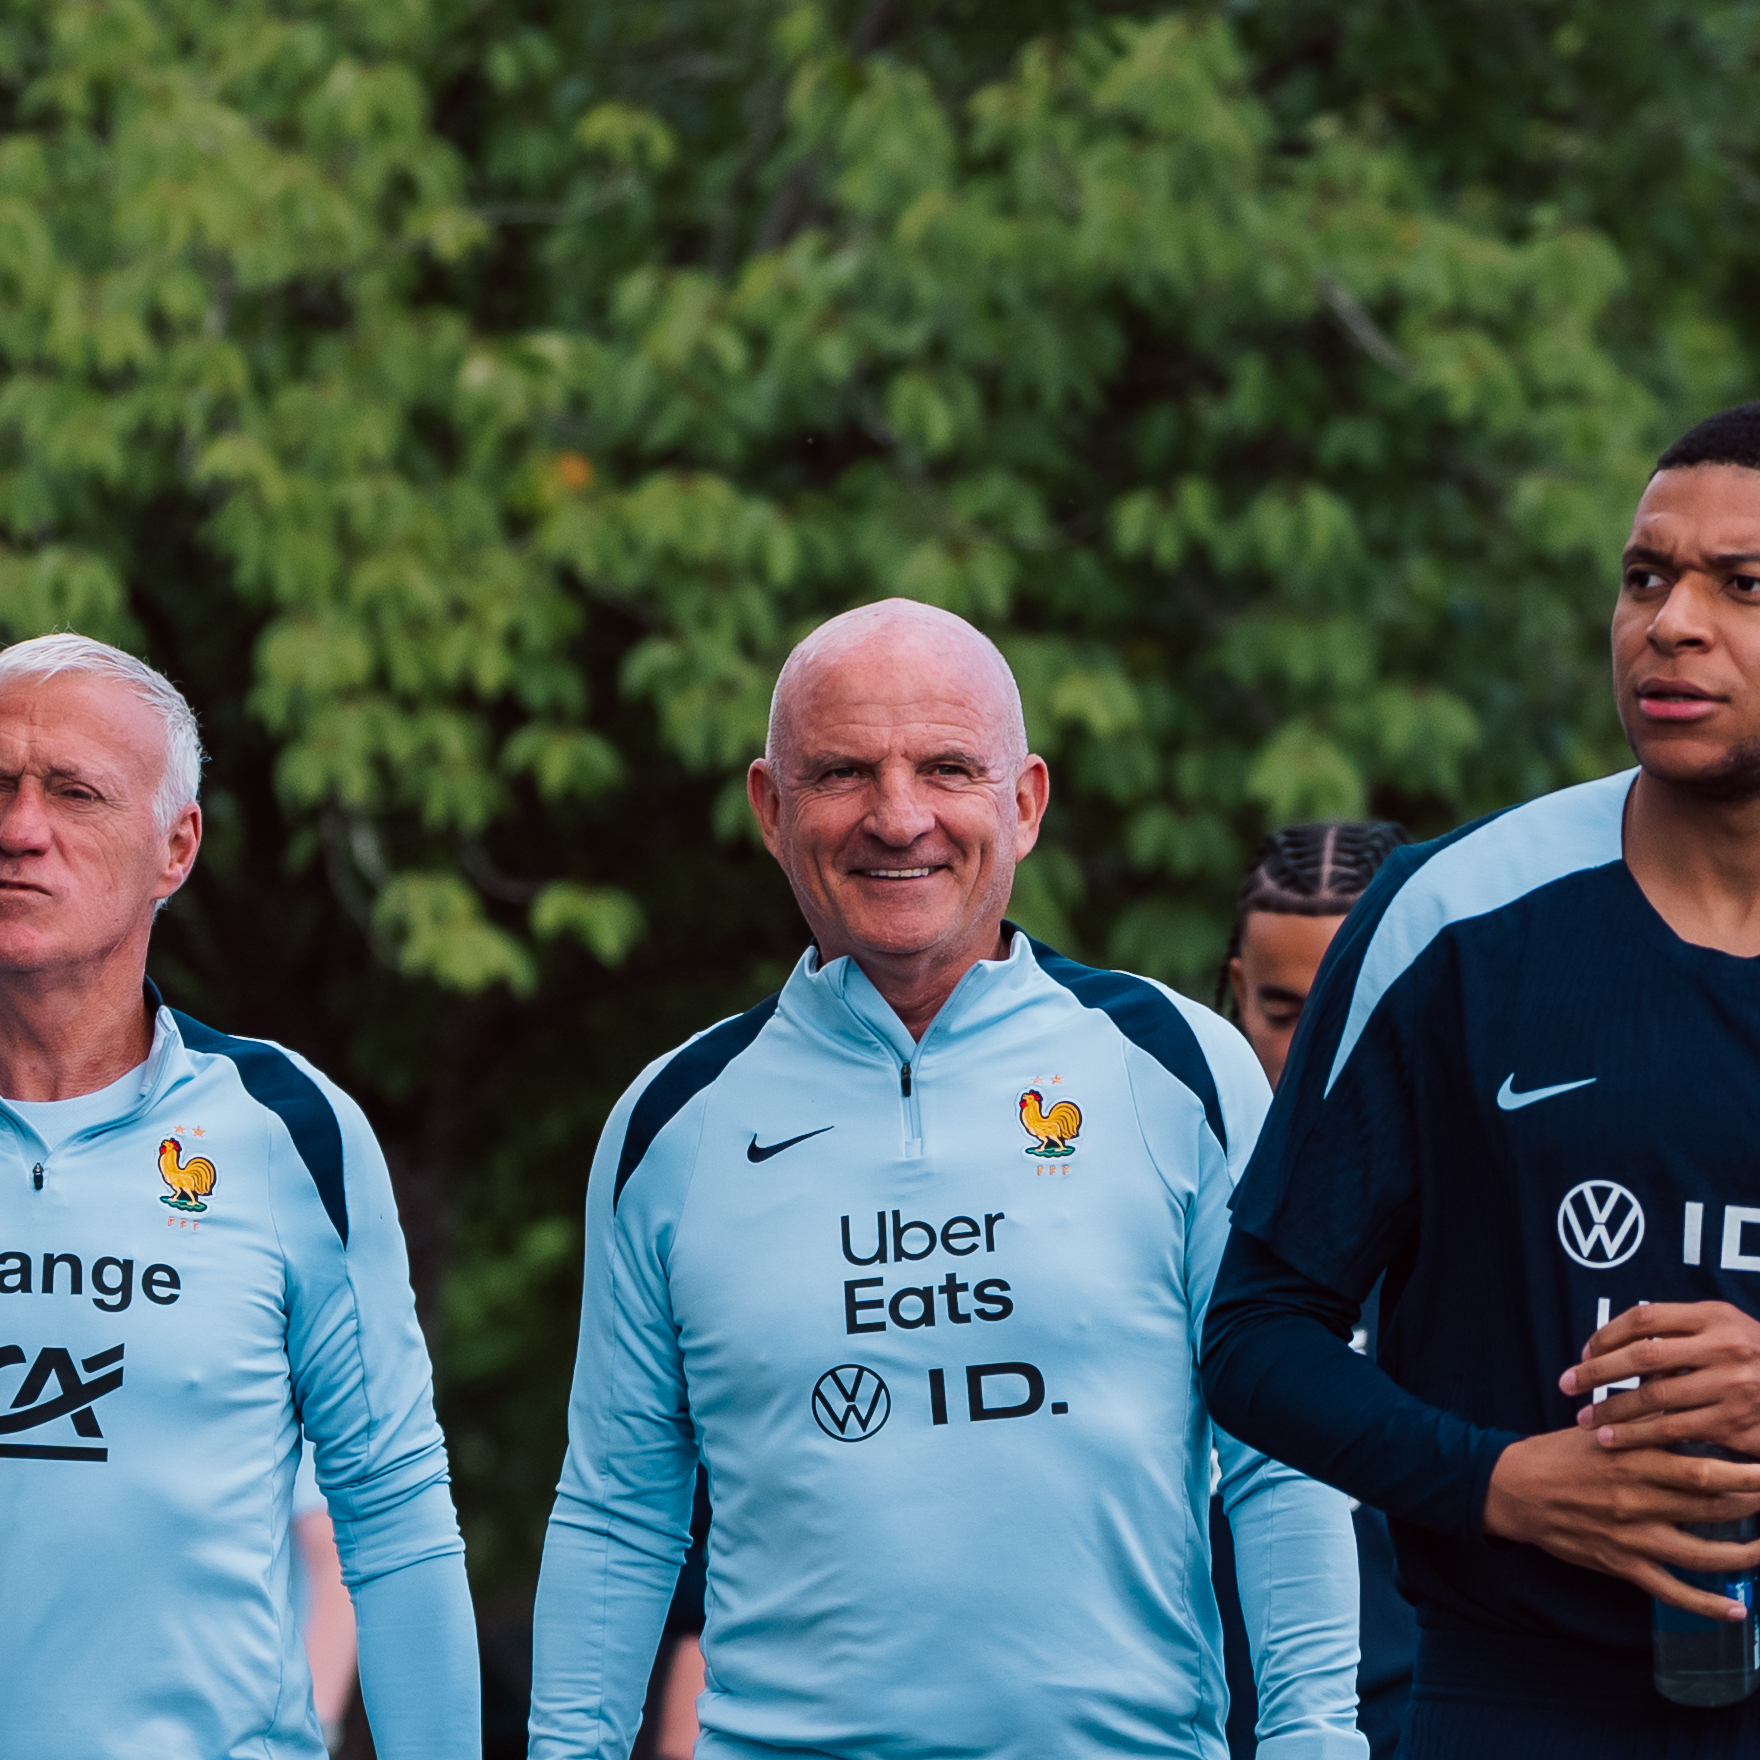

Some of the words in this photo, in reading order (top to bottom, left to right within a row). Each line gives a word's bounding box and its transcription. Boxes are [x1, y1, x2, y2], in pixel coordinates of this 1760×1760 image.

[840, 1209, 1006, 1266] Uber
[1557, 1180, 1645, 1269] VW
[843, 1272, 1014, 1335] Eats
[811, 1363, 892, 1443] VW
[928, 1361, 1070, 1426] ID.
